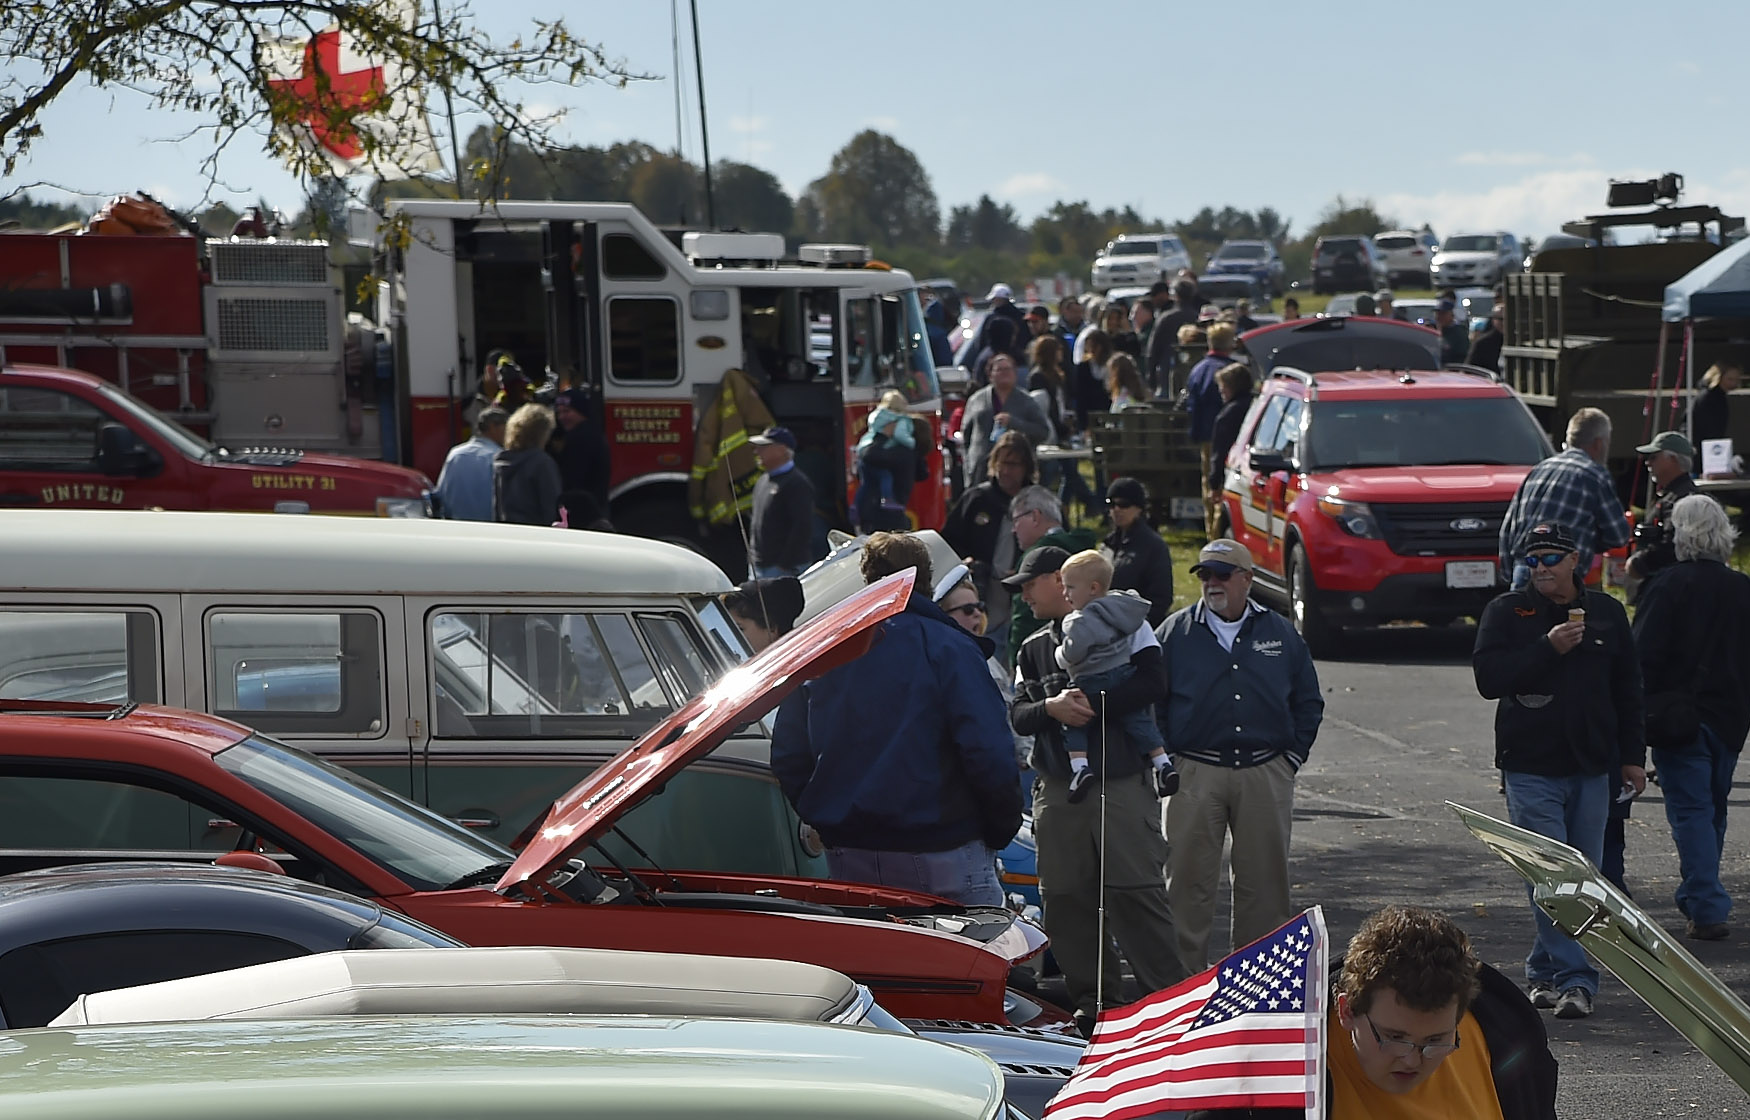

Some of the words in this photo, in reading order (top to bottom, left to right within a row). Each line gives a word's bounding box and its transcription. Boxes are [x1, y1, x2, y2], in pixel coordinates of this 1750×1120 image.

[614, 408, 681, 418] FREDERICK
[624, 421, 670, 430] COUNTY
[615, 433, 680, 443] MARYLAND
[252, 473, 315, 489] UTILITY
[320, 476, 336, 490] 31
[42, 483, 125, 504] UNITED
